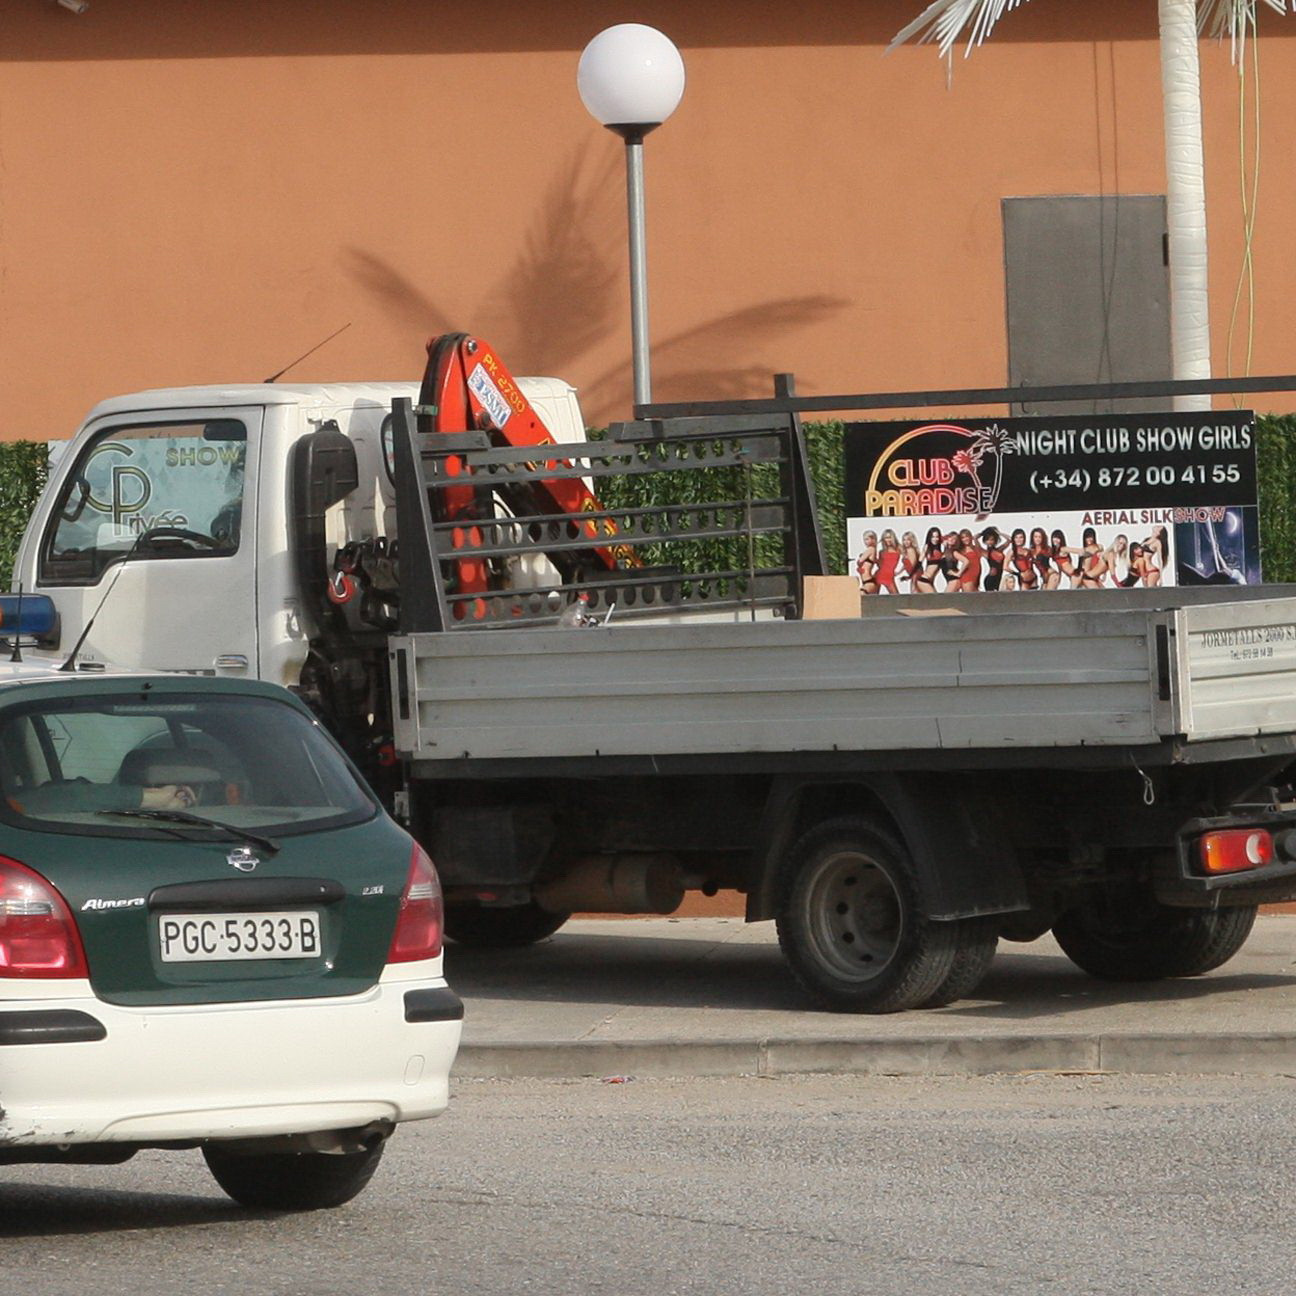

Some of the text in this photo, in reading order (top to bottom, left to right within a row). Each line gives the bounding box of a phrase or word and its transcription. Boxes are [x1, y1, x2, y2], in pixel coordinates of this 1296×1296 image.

[1016, 424, 1252, 456] NIGHT CLUB SHOW GIRLS
[164, 446, 240, 468] SHOW
[887, 458, 955, 487] CLUB
[1029, 464, 1241, 493] (+34) 872 00 41 55
[865, 486, 993, 517] PARADISE
[1081, 506, 1226, 526] AERIAL SILK SHOW
[80, 897, 145, 913] Almera
